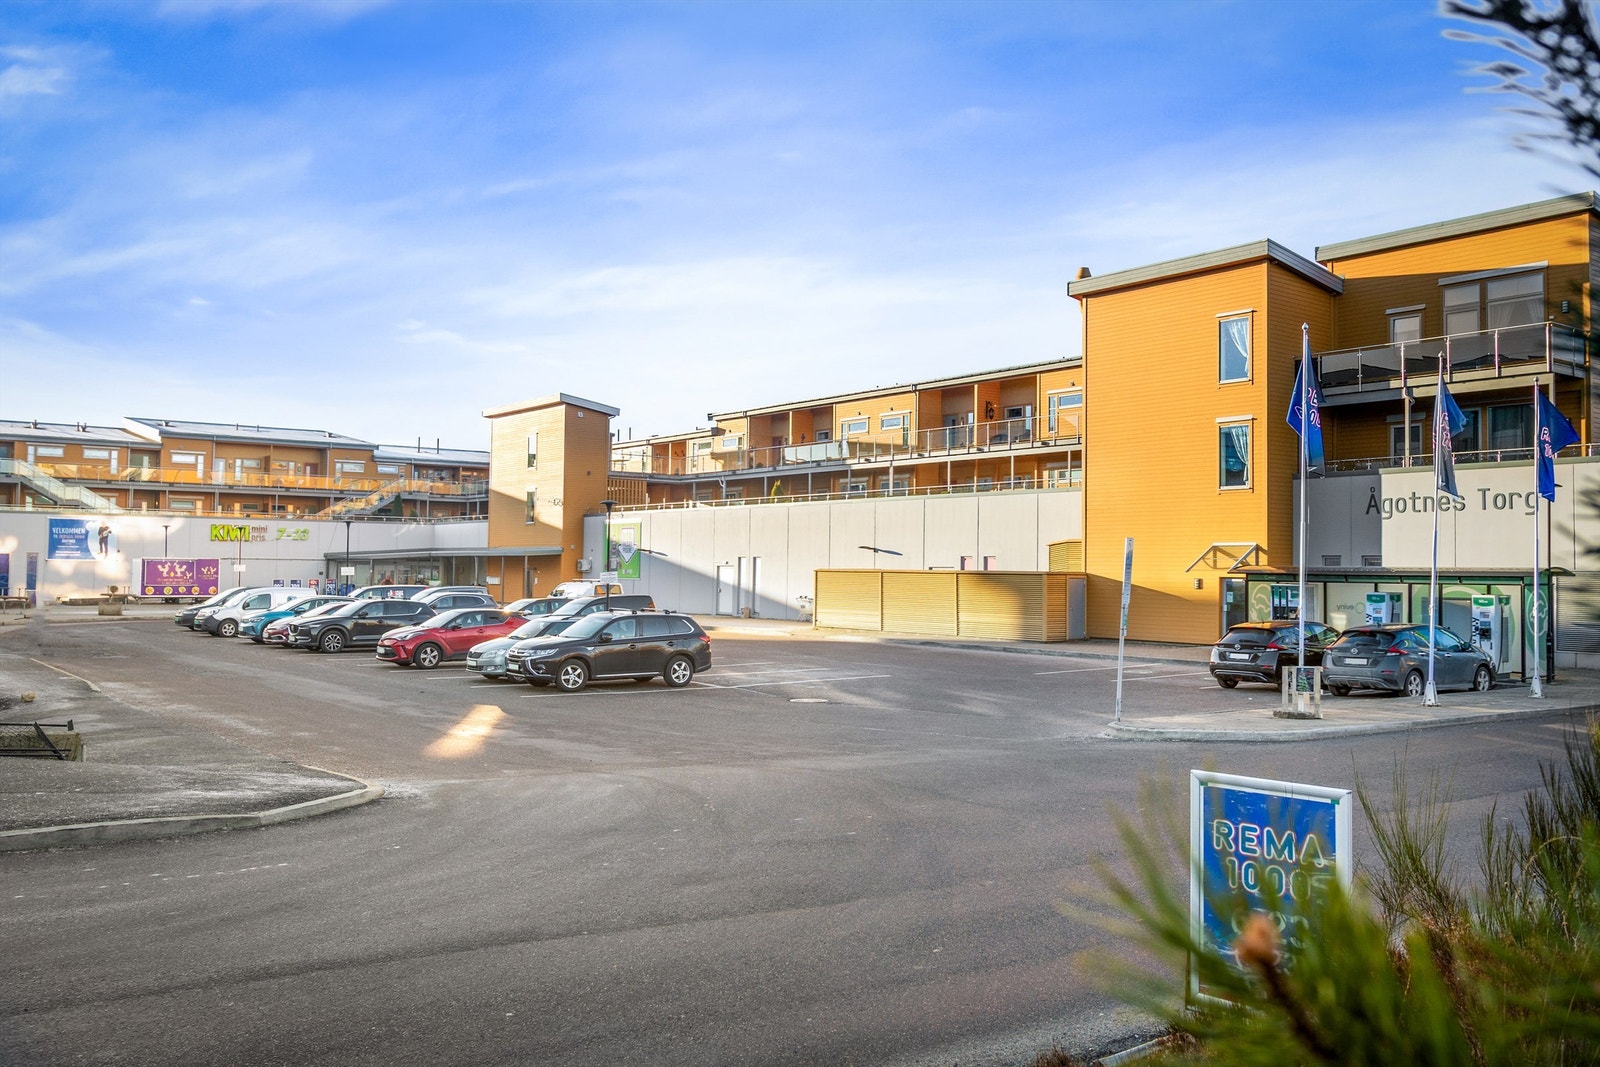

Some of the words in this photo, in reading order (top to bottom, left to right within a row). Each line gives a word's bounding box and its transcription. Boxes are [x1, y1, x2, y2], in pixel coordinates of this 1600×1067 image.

[1365, 487, 1466, 520] Ågotnes
[1477, 488, 1536, 516] Torg
[210, 524, 250, 542] KIWI
[251, 525, 268, 534] mini
[251, 534, 266, 543] pris
[1213, 819, 1325, 868] REMA
